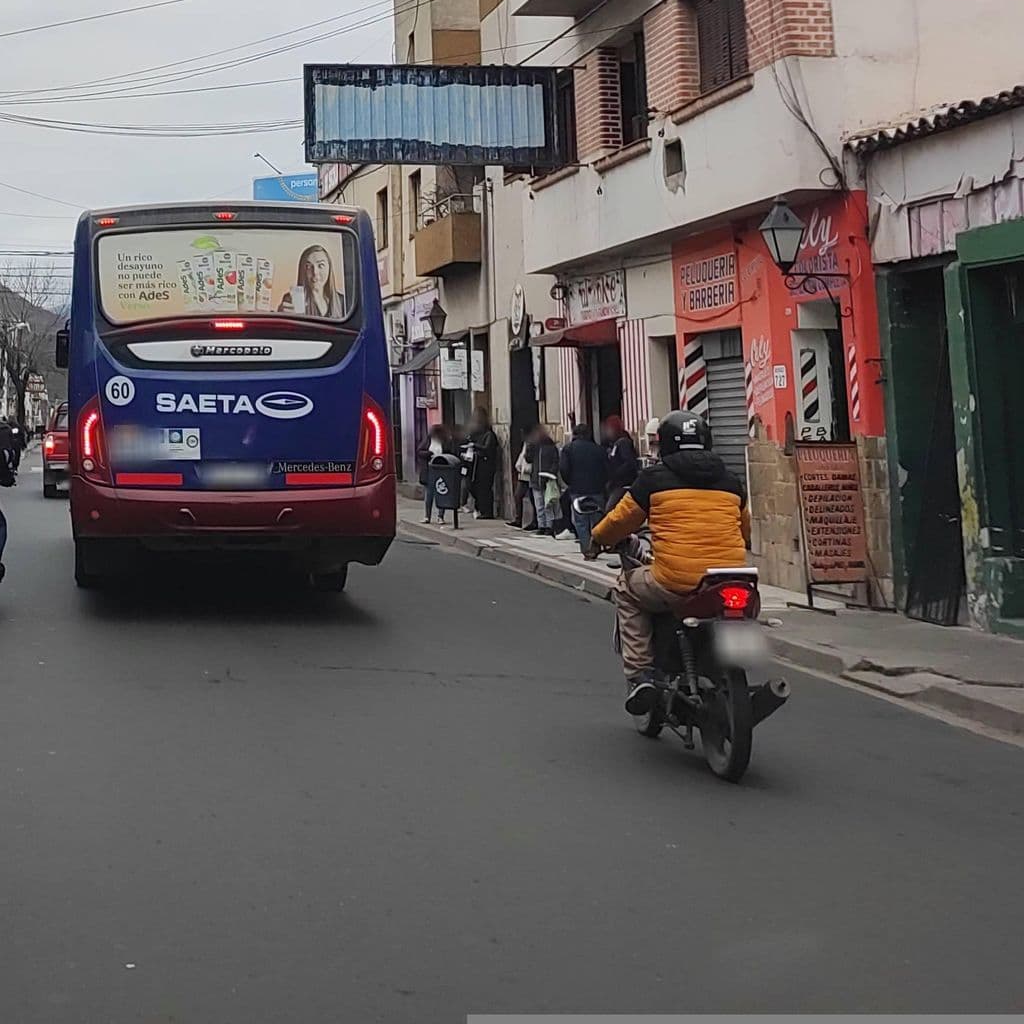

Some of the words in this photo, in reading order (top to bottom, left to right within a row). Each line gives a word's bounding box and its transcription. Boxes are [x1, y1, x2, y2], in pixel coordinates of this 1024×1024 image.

[117, 253, 131, 262] Un
[134, 252, 153, 262] rico
[117, 262, 164, 272] desayuno
[679, 252, 736, 286] PELUQUERIA
[132, 271, 162, 281] puede
[136, 280, 156, 289] más
[158, 280, 177, 289] rico
[118, 291, 136, 299] con
[139, 290, 170, 301] AdeS
[681, 289, 688, 313] Y
[689, 279, 736, 312] BARBERIA
[205, 345, 271, 356] Marcopolo
[110, 381, 130, 400] 60
[155, 392, 256, 415] SAETA
[278, 461, 353, 473] Mercedes-Benz
